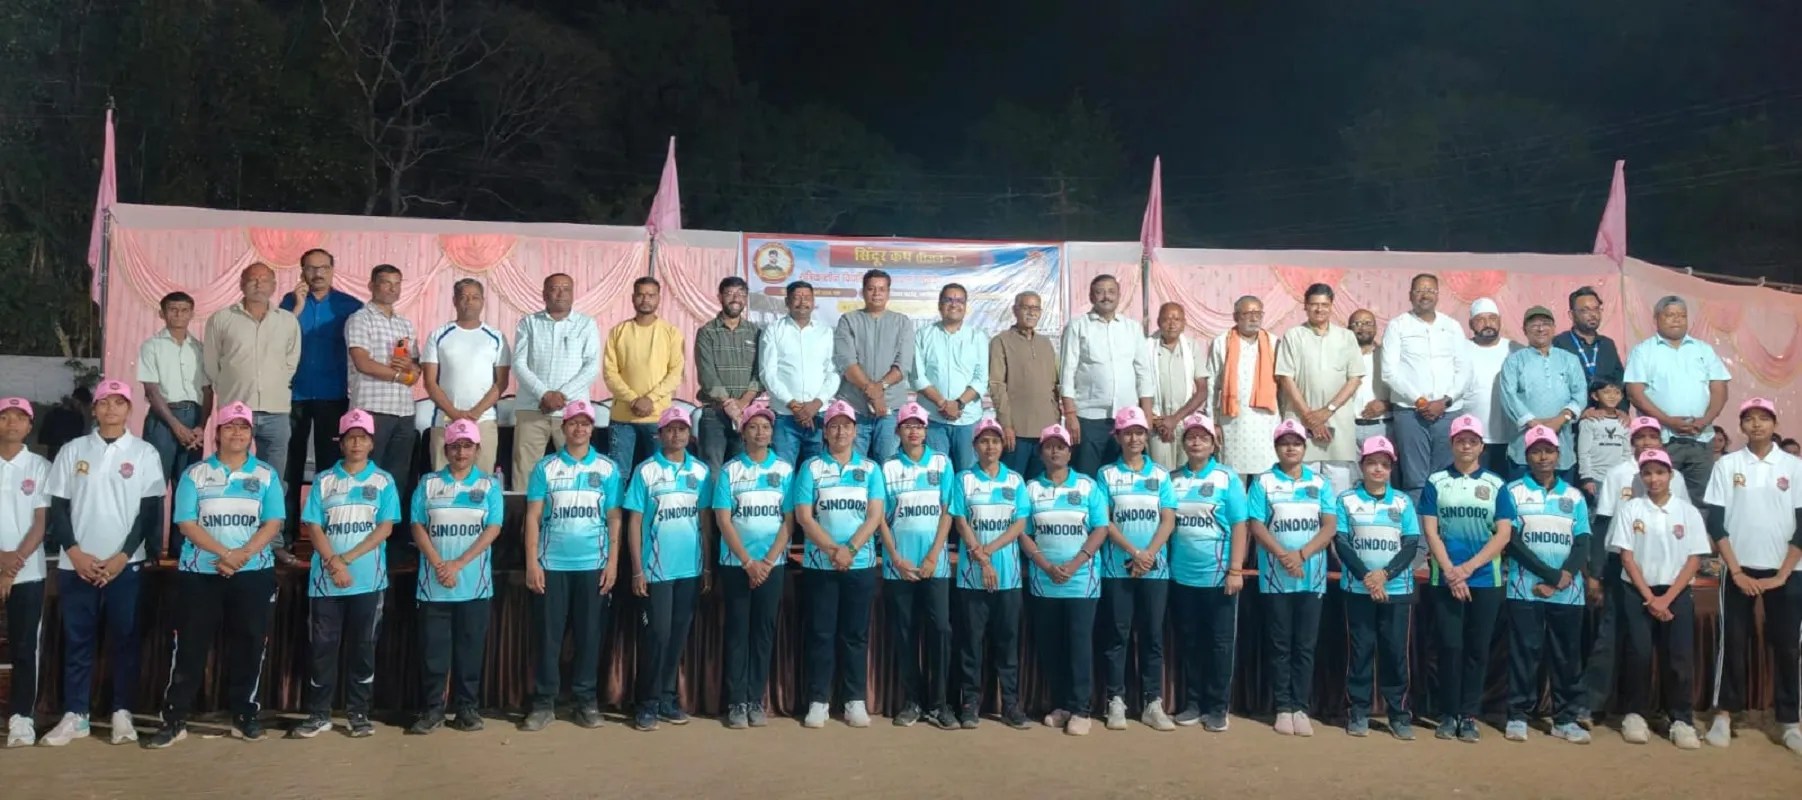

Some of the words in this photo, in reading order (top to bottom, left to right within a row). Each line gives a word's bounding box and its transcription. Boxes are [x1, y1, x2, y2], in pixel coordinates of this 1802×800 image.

[854, 246, 887, 266] सिंदूर
[736, 504, 781, 518] SINDOOR
[819, 499, 867, 512] SINDOOR
[658, 507, 698, 521] SINDOOR
[1115, 510, 1157, 523] SINDOOR
[1440, 506, 1488, 520] SINDOOR
[202, 514, 257, 527] SINDOOR
[1174, 515, 1214, 529] NDOOR
[1274, 518, 1319, 533] SINDOOR
[327, 521, 374, 536] SINDOOR
[430, 525, 481, 538] SINDOOR
[1354, 538, 1398, 552] SINDOOR
[1524, 531, 1571, 546] SINDOOR
